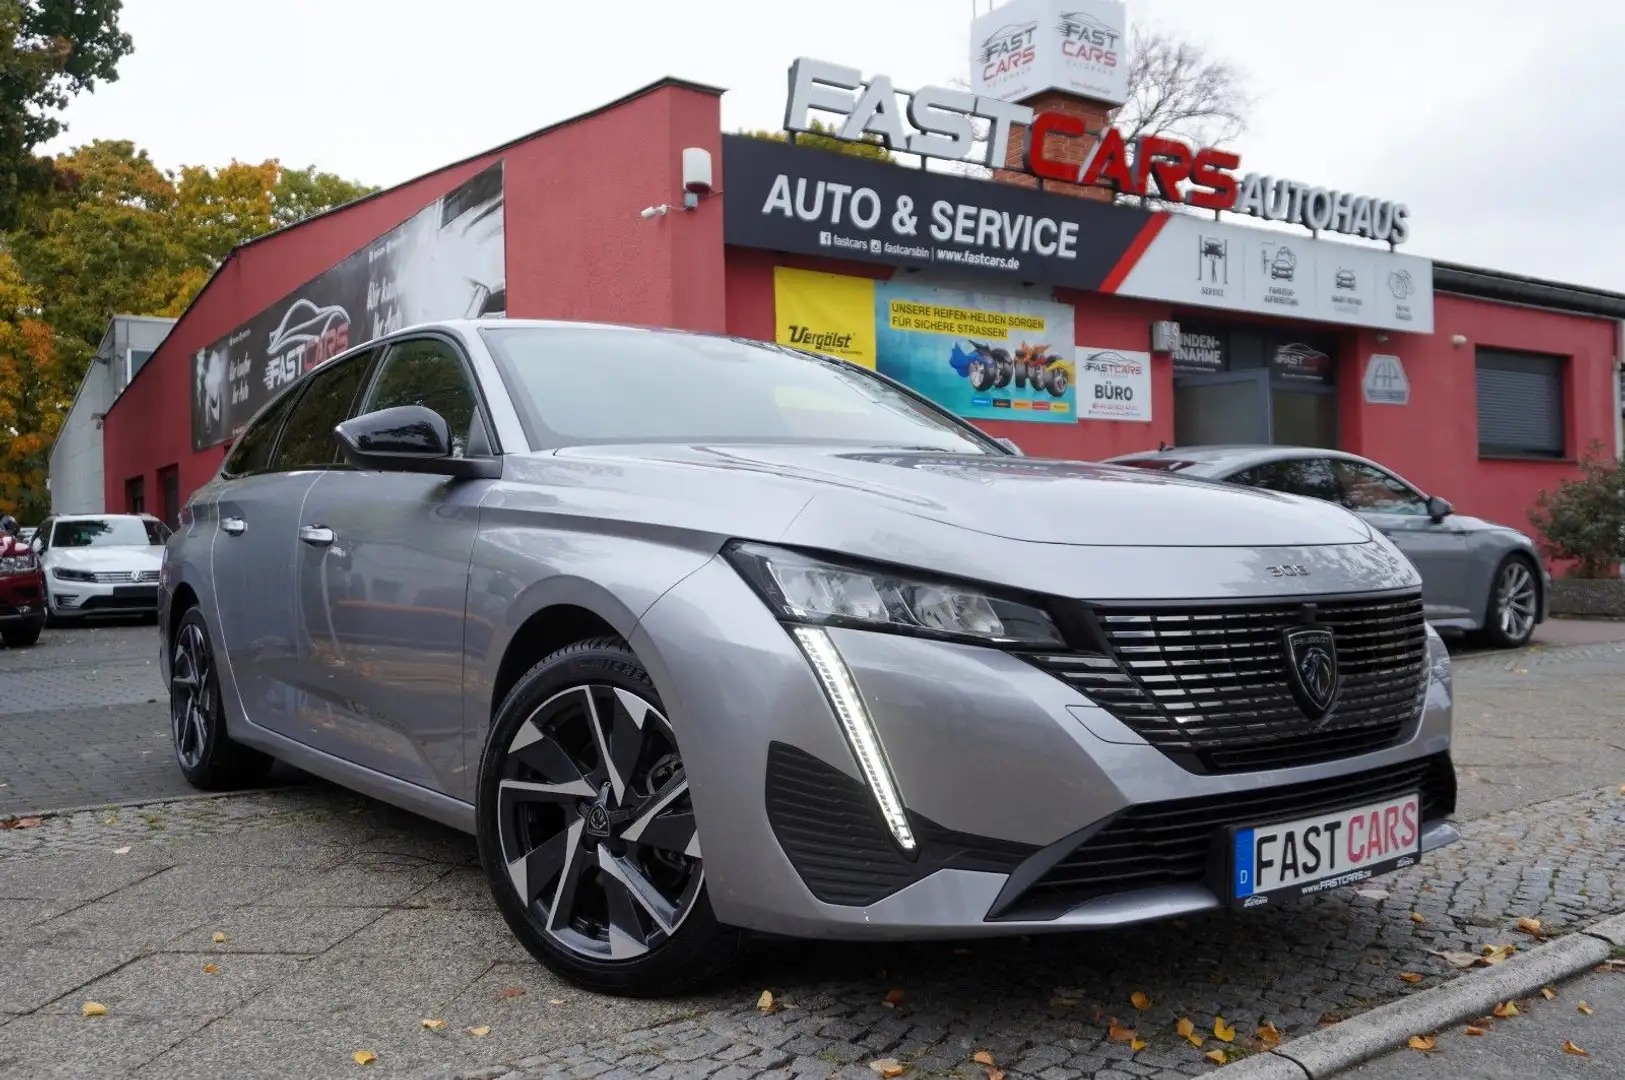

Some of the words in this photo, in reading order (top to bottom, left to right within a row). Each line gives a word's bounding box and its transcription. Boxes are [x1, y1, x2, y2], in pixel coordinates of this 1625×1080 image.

[983, 25, 1037, 62] FAST
[1060, 22, 1119, 49] FAST
[983, 45, 1035, 81] CARS
[1062, 40, 1117, 67] CARS
[762, 174, 881, 229] AUTO
[892, 195, 918, 235] &
[930, 200, 1079, 259] SERVICE
[1236, 172, 1409, 244] AUTOHAUS
[833, 234, 868, 249] fastcars
[937, 248, 1020, 270] www.fastcars.de
[892, 303, 930, 317] UNSERE
[933, 308, 1006, 325] REIFEN-HELDEN
[1008, 316, 1044, 330] SORGEN
[892, 316, 912, 327] FÜR
[914, 319, 955, 333] SICHERE
[957, 323, 1008, 338] STRASSEN!
[788, 325, 852, 349] Vergölst
[1094, 380, 1133, 401] BÜRO
[1240, 869, 1248, 884] D
